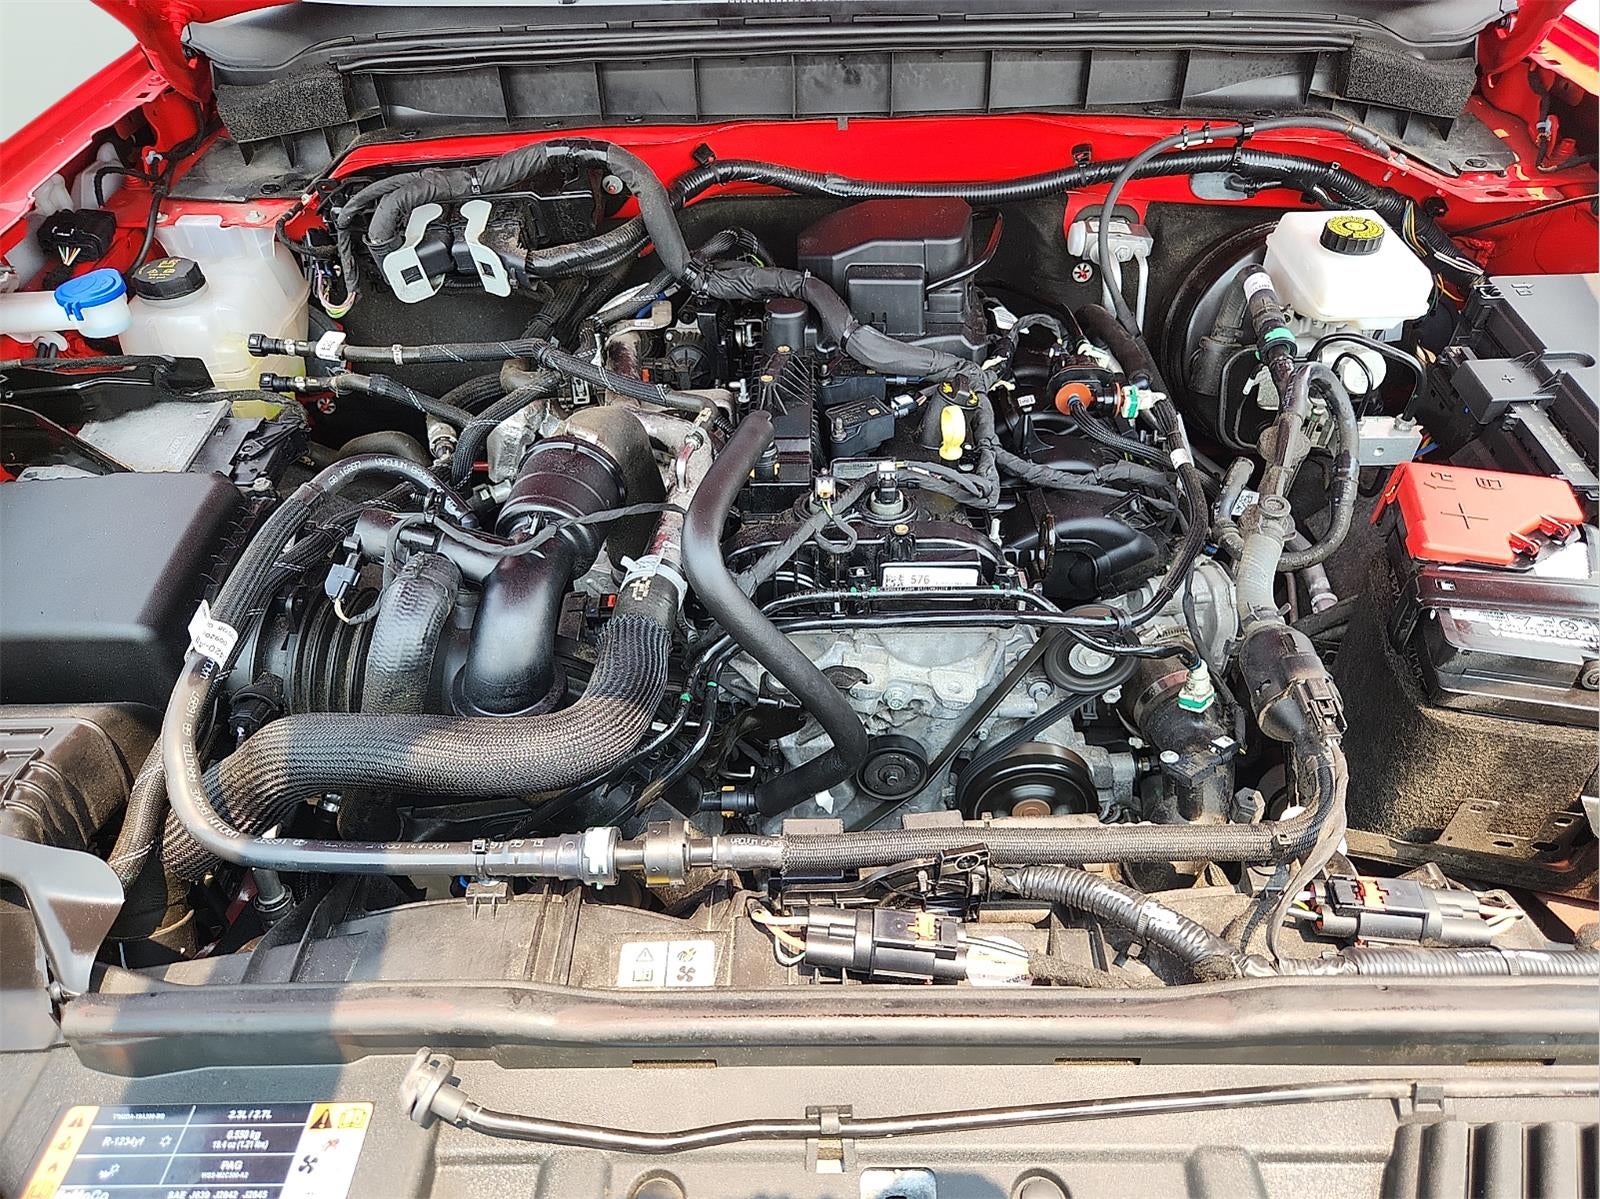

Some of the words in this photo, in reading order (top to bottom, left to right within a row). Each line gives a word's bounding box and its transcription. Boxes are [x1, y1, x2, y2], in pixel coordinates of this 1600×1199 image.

[374, 458, 408, 471] VACUUM
[910, 574, 931, 585] 576
[186, 690, 201, 718] 16897
[190, 787, 210, 817] BRAKE
[208, 817, 241, 839] VACUUM
[249, 1130, 261, 1141] kg
[102, 1136, 146, 1148] R-1234yf
[220, 1160, 244, 1171] PAG
[167, 1190, 188, 1199] SAE
